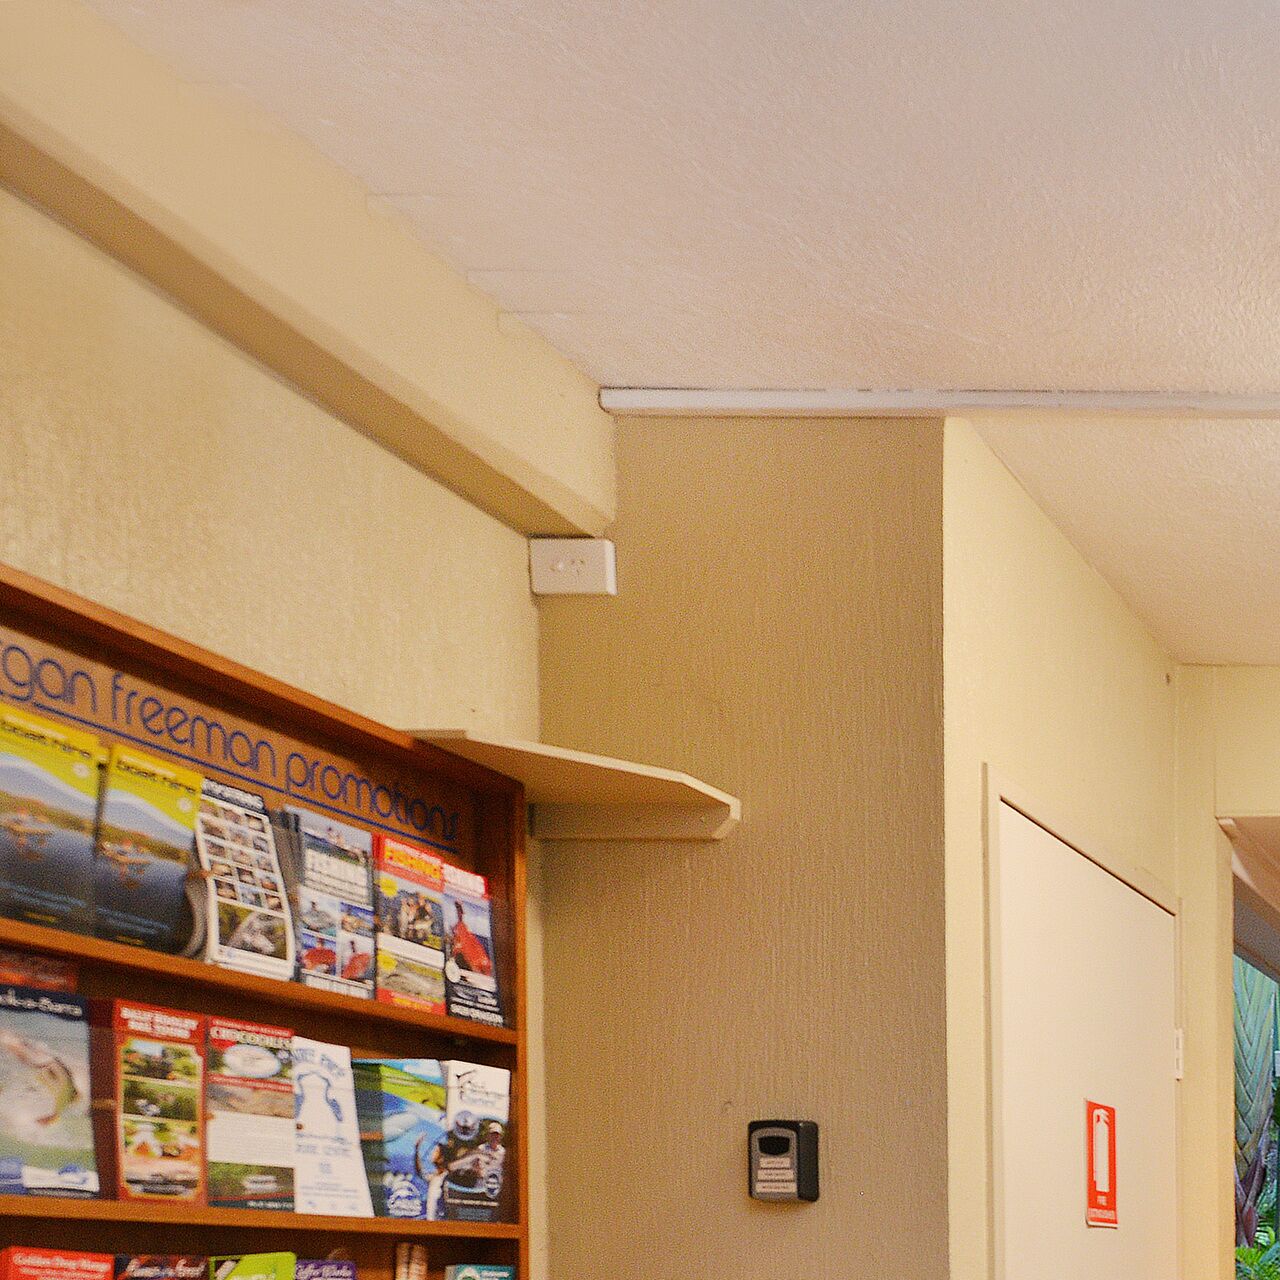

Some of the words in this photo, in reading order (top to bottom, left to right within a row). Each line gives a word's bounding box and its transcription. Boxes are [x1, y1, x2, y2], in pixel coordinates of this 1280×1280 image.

[0, 645, 97, 709] gan
[111, 672, 277, 778] freeman
[285, 752, 459, 842] promotions
